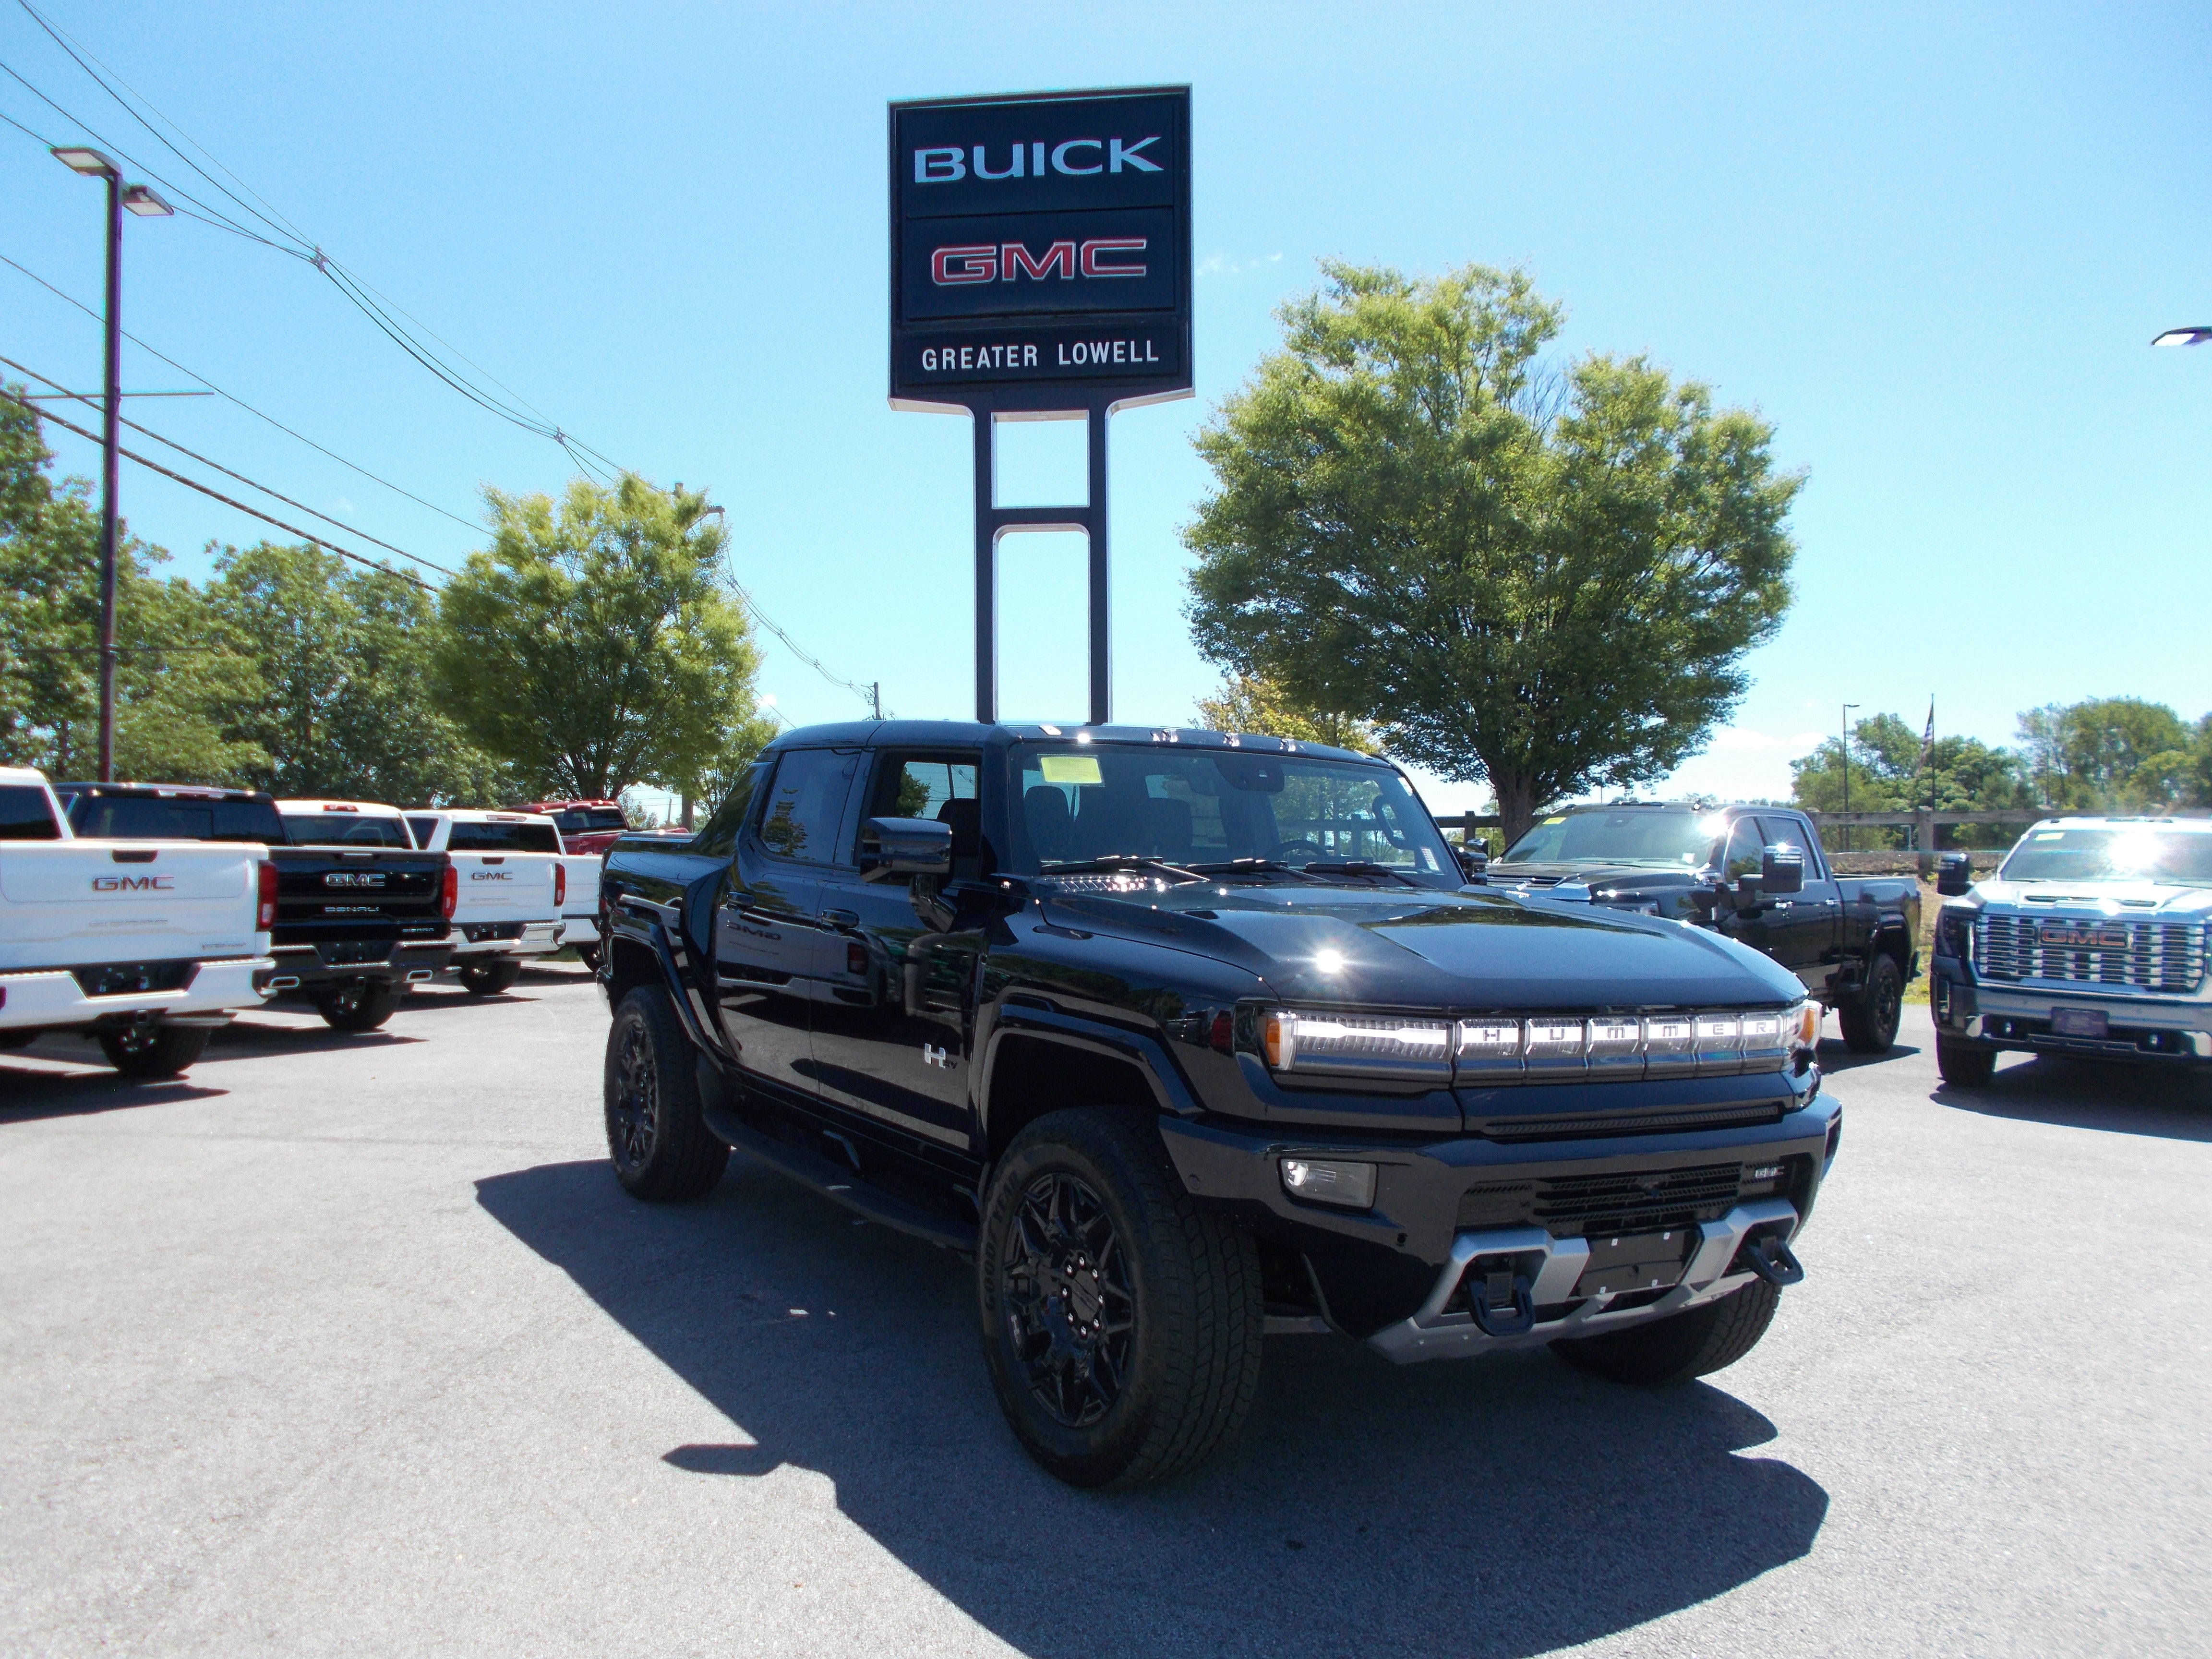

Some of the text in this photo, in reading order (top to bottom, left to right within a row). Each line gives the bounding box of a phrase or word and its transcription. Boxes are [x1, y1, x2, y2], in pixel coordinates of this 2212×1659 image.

[914, 137, 1165, 183] BUICK
[932, 239, 1147, 286] GMC
[922, 340, 1159, 371] GREATER LOWELL
[93, 876, 175, 891] GMC
[327, 874, 385, 887] GMC
[471, 872, 513, 880] GMC
[2042, 929, 2126, 947] GMC
[1483, 1022, 1766, 1042] HUMMER
[1755, 1165, 1785, 1178] GMC
